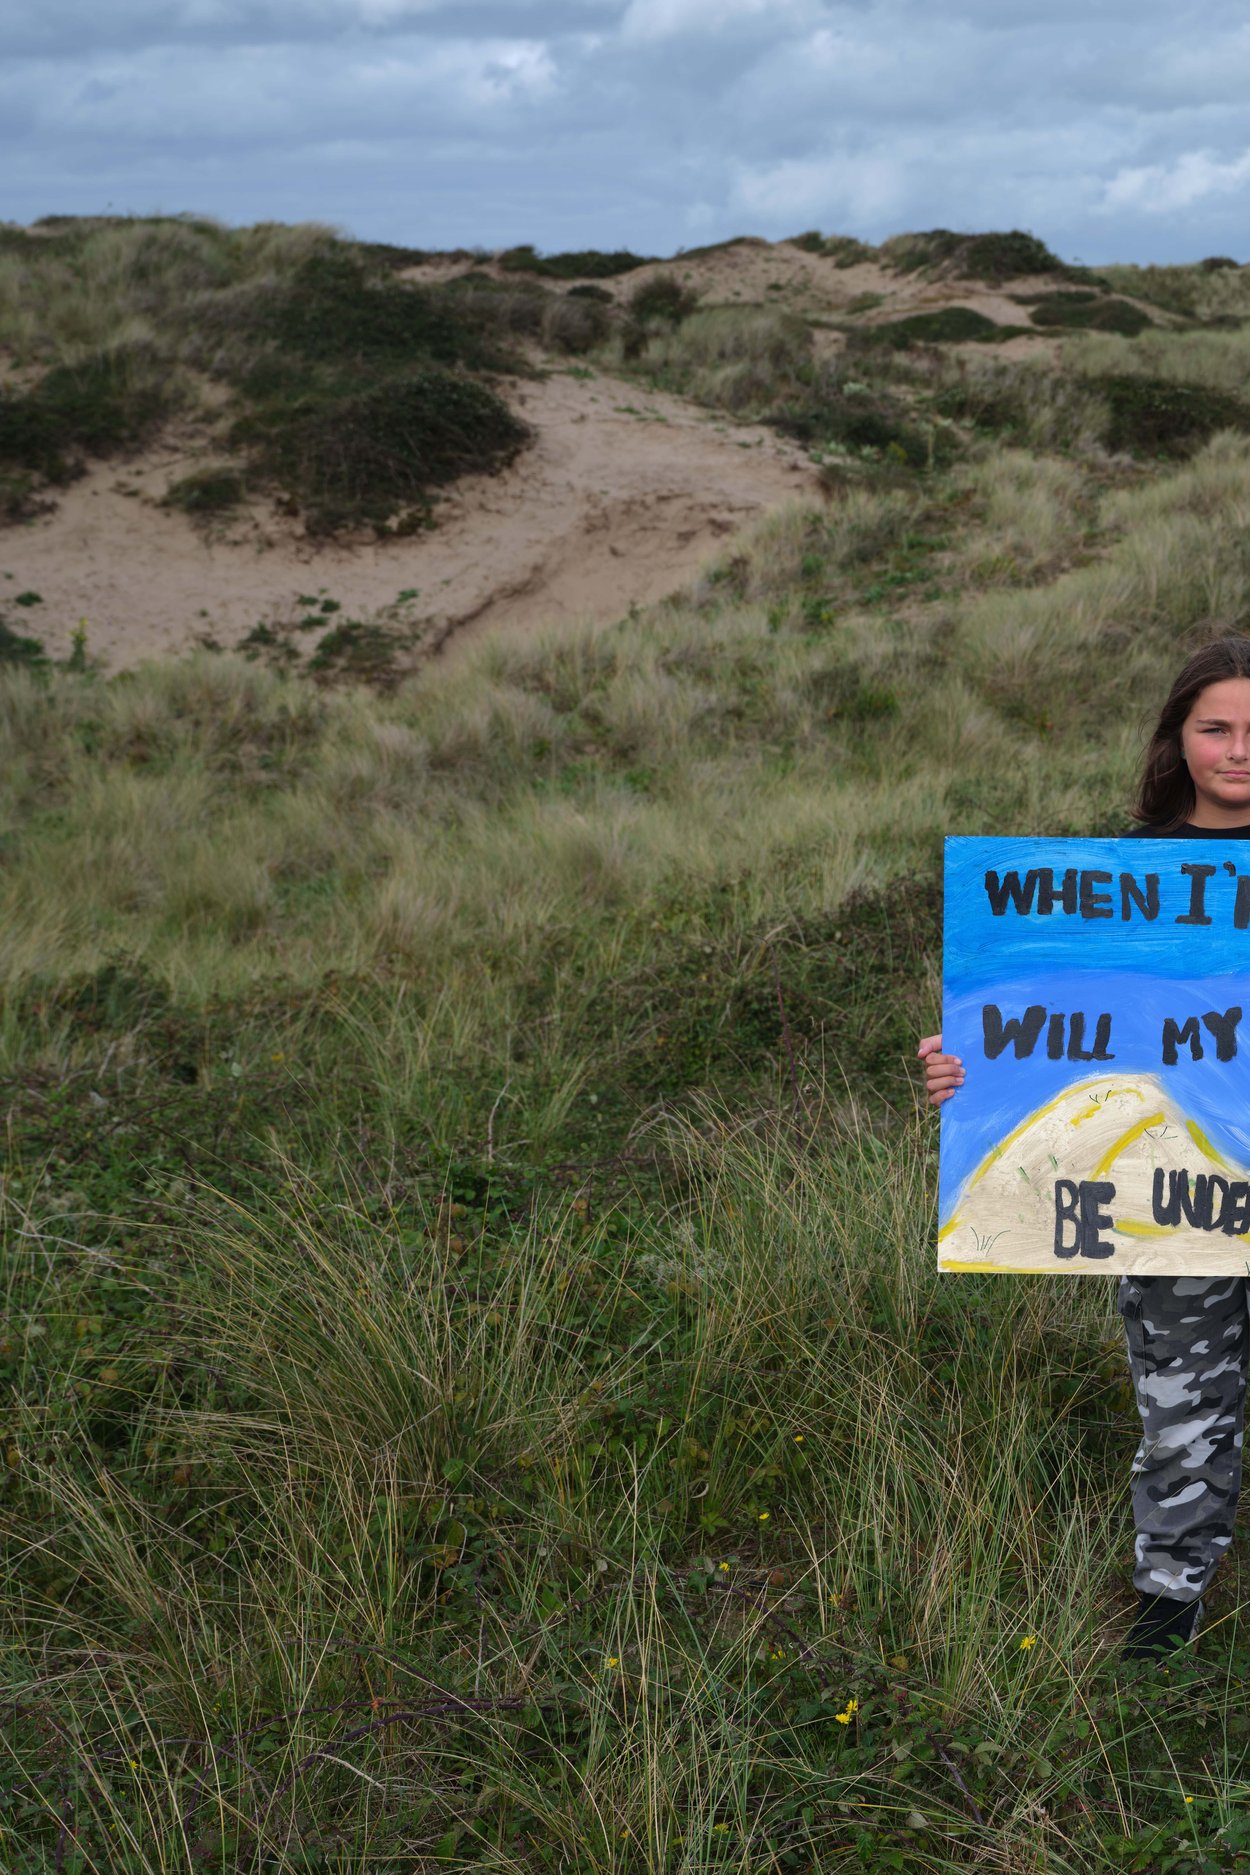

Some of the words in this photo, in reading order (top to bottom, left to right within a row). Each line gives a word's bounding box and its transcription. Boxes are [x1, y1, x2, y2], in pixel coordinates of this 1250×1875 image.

[985, 867, 1160, 921] WHEN
[982, 1004, 1115, 1062] WILL
[1162, 1006, 1242, 1065] MY
[1053, 1179, 1116, 1259] BE
